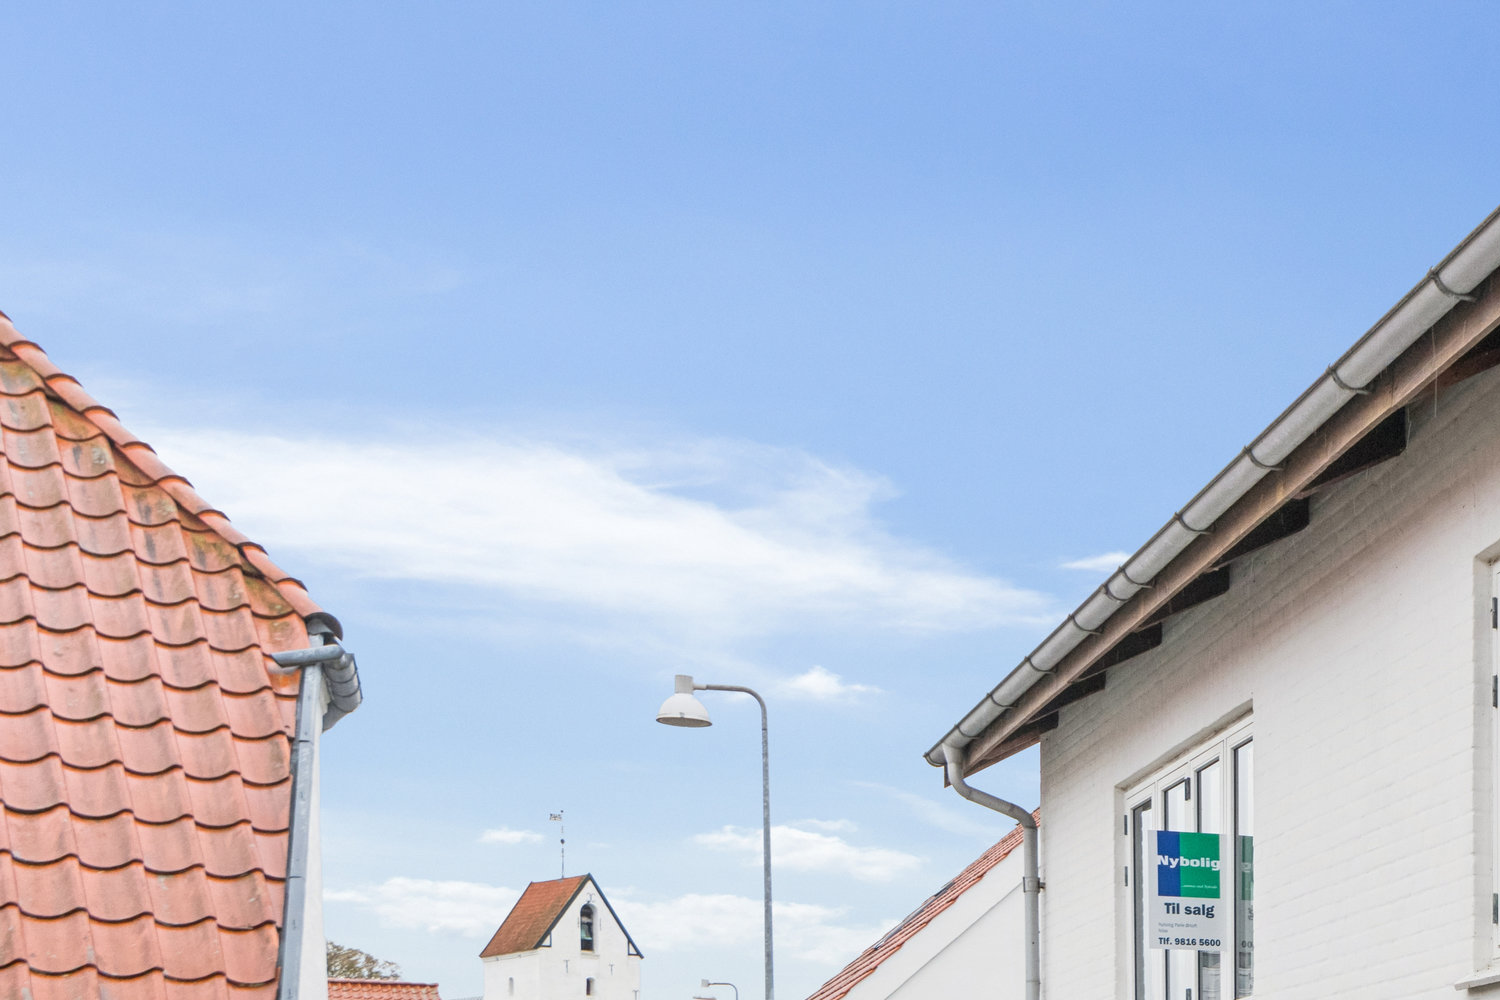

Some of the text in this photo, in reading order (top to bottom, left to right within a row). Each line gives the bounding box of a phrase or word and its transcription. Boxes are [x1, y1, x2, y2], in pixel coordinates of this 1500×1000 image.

[1157, 854, 1220, 871] Nybolig
[1164, 902, 1215, 919] Til salg
[1174, 937, 1197, 946] 9816
[1198, 938, 1221, 947] 5600
